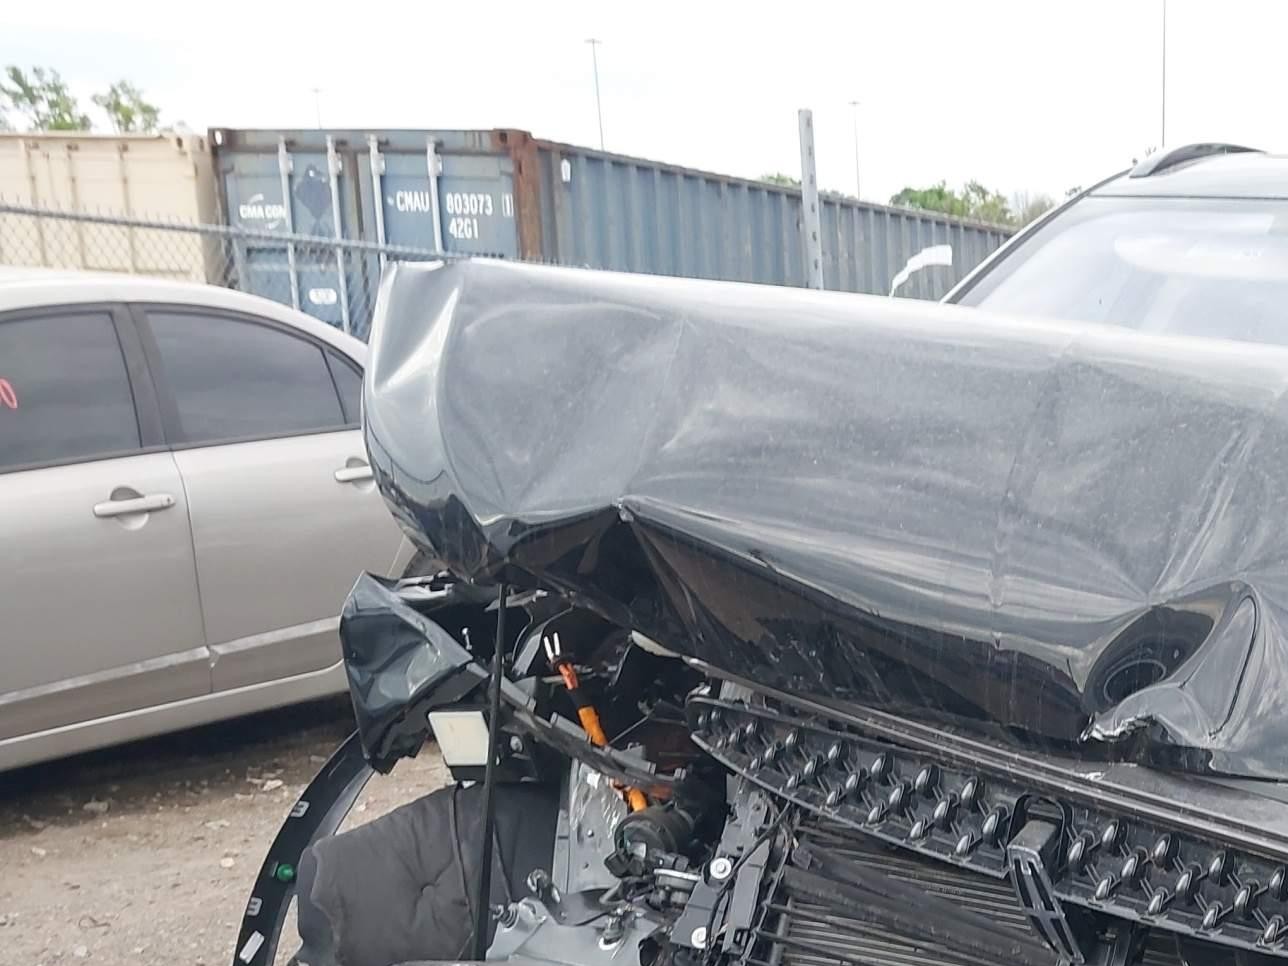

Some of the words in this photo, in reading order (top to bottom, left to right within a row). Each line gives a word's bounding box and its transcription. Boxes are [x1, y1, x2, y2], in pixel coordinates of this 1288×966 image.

[239, 204, 265, 219] CMA
[396, 190, 430, 213] CMAU
[446, 192, 493, 216] 803073
[449, 217, 479, 239] 42G1
